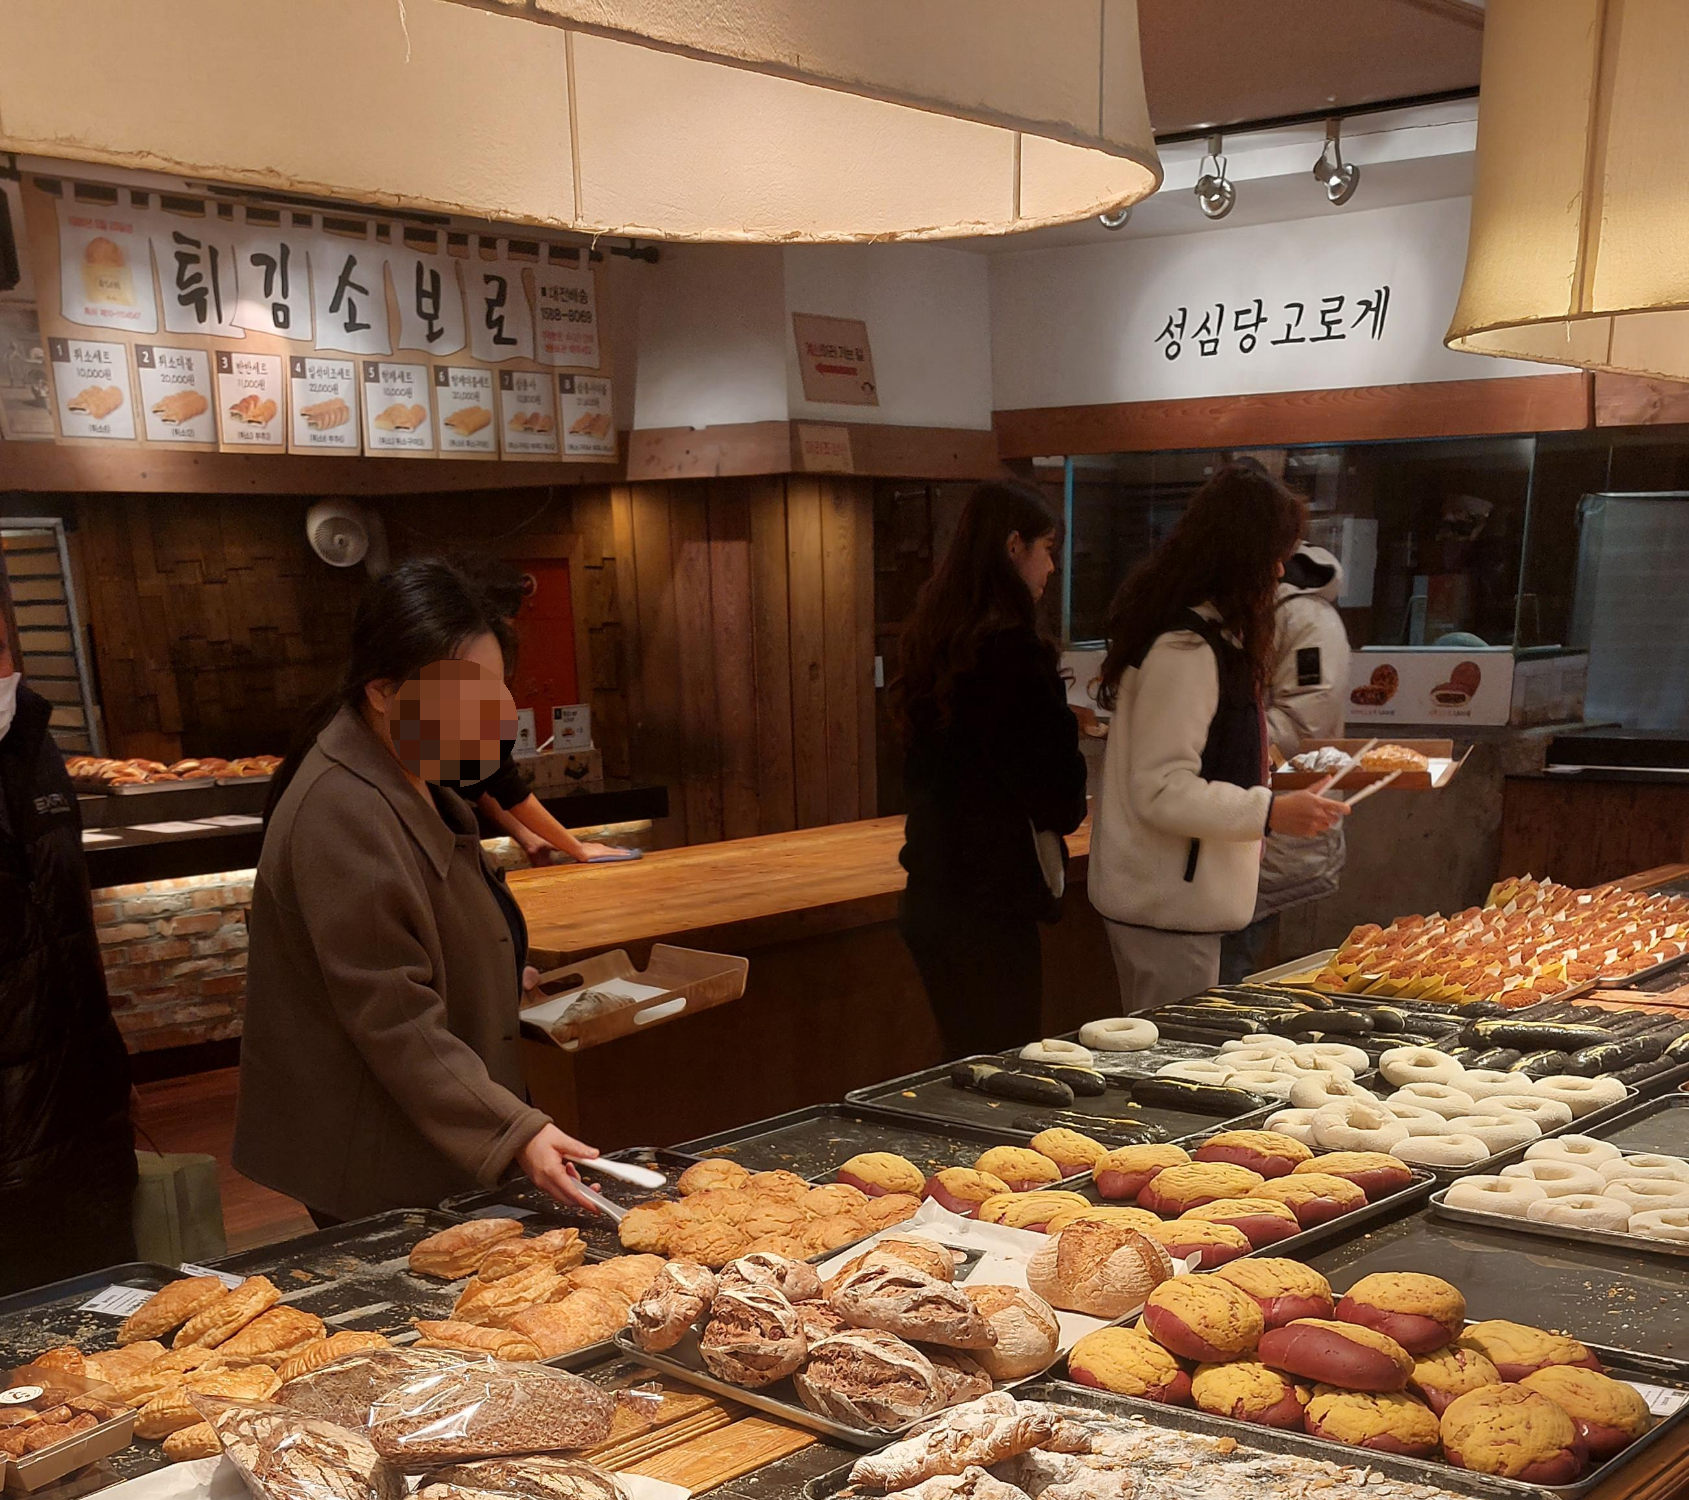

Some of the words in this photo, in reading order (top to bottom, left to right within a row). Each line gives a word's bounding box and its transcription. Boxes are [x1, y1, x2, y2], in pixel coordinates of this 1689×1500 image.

[172, 230, 519, 347] 튀김소보로
[56, 344, 62, 356] 1
[142, 351, 149, 364] 2
[221, 356, 229, 369] 3
[295, 362, 302, 374] 4
[368, 367, 376, 379] 5
[438, 372, 445, 383] 6
